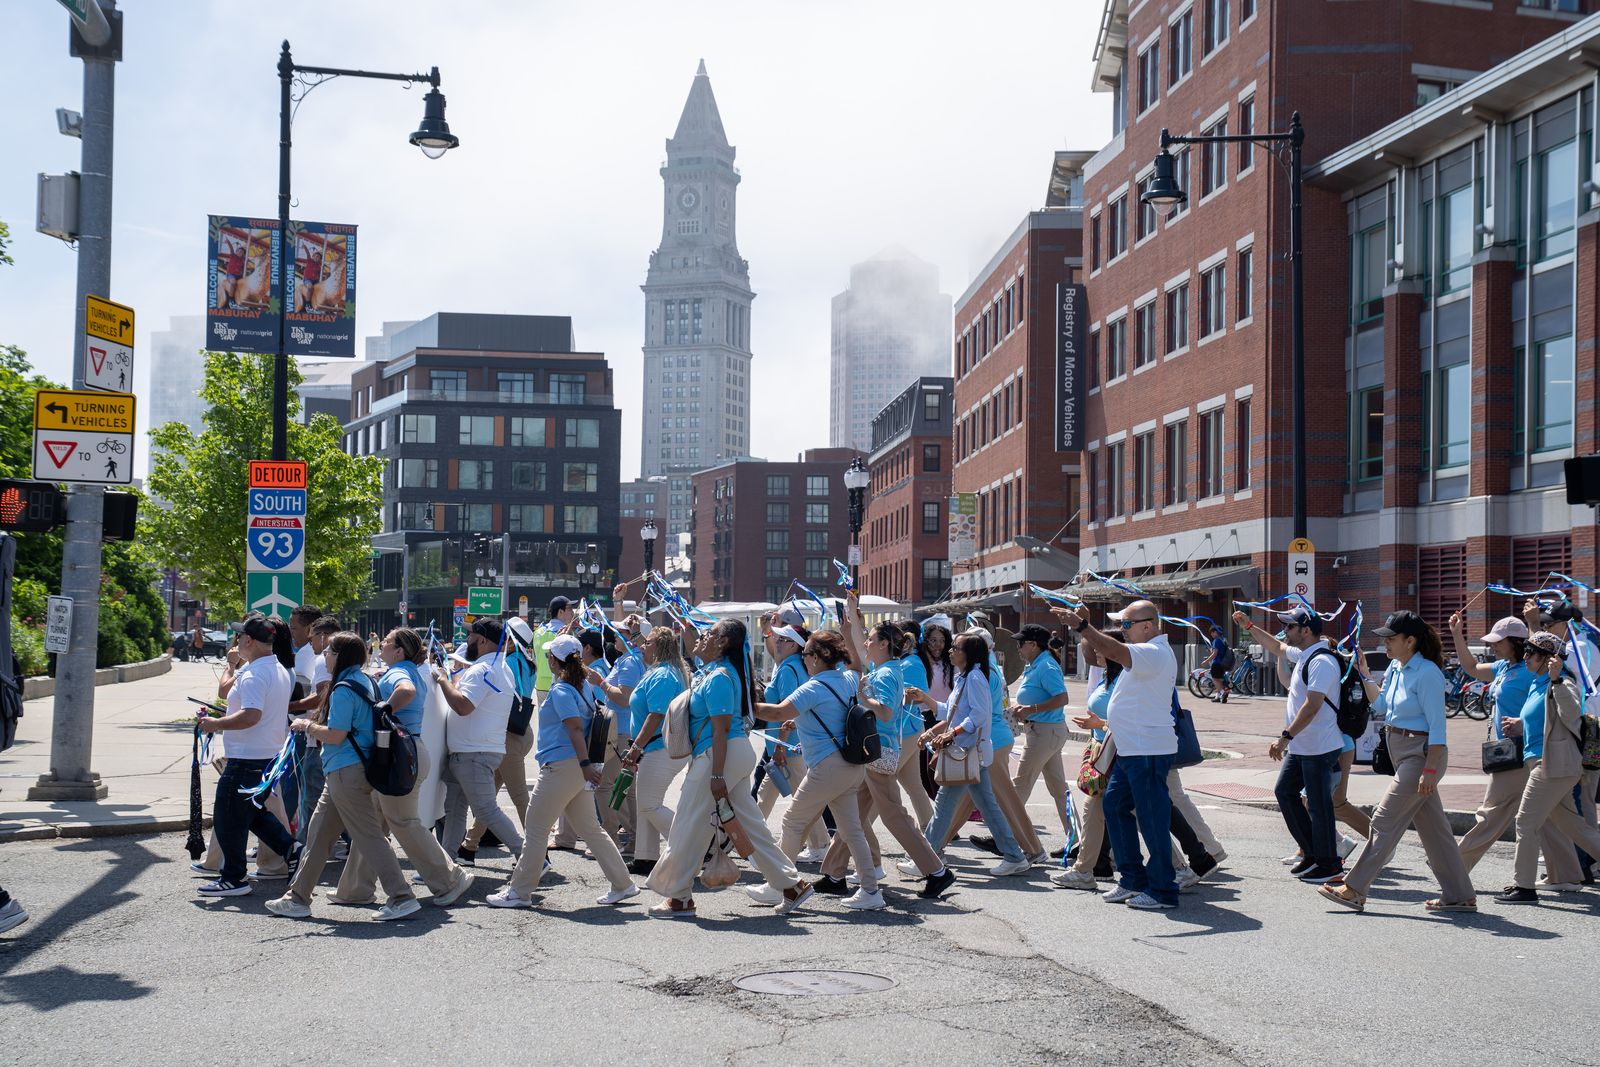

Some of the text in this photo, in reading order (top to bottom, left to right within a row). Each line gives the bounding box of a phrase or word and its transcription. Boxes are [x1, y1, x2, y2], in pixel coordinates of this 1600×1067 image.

[271, 229, 280, 285] BIENVENUE
[346, 235, 355, 290] BIENVENUE
[209, 259, 218, 308] WELCOME
[286, 264, 295, 313] WELCOME
[91, 306, 117, 323] TURNING
[208, 308, 261, 318] MABUHAY
[286, 313, 337, 322] MABUHAY
[89, 321, 118, 337] VEHICLES
[106, 361, 113, 371] TO
[1063, 287, 1076, 447] Registry of Motor Vehicles
[74, 402, 125, 415] TURNING
[71, 416, 128, 428] VEHICLES
[78, 452, 91, 461] TO
[255, 467, 302, 483] DETOUR
[254, 493, 302, 511] SOUTH
[256, 520, 296, 528] INTERSTATE
[258, 532, 294, 558] 93
